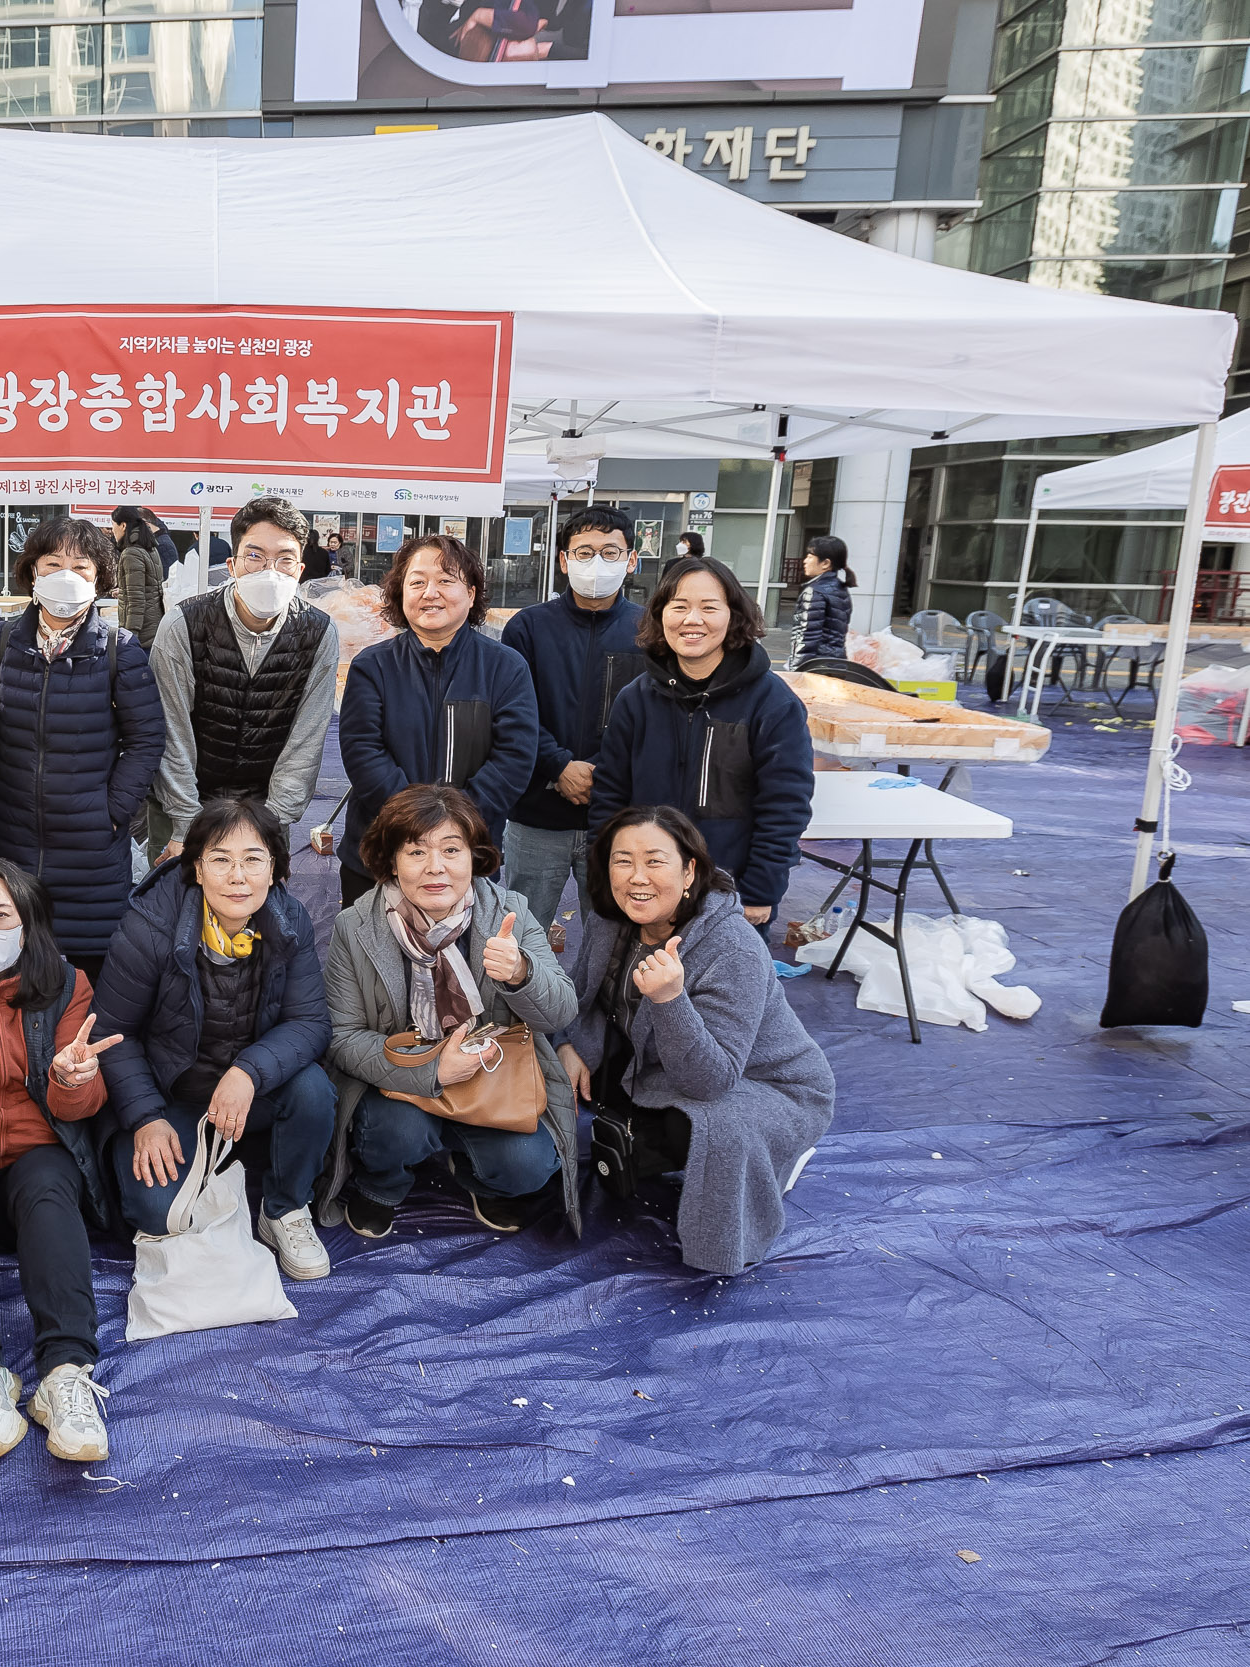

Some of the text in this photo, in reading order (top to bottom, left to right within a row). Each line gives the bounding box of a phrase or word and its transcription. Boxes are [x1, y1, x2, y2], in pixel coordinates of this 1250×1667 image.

[119, 336, 313, 357] 지역가치를 높이는 실천의 광장
[34, 479, 59, 495] 광진
[61, 478, 100, 495] 사랑의
[105, 479, 155, 496] 김장축제
[206, 484, 233, 494] 광진구
[266, 487, 304, 496] 광진복지재단
[336, 489, 377, 499] KB 국민은행
[1218, 489, 1250, 514] 광진
